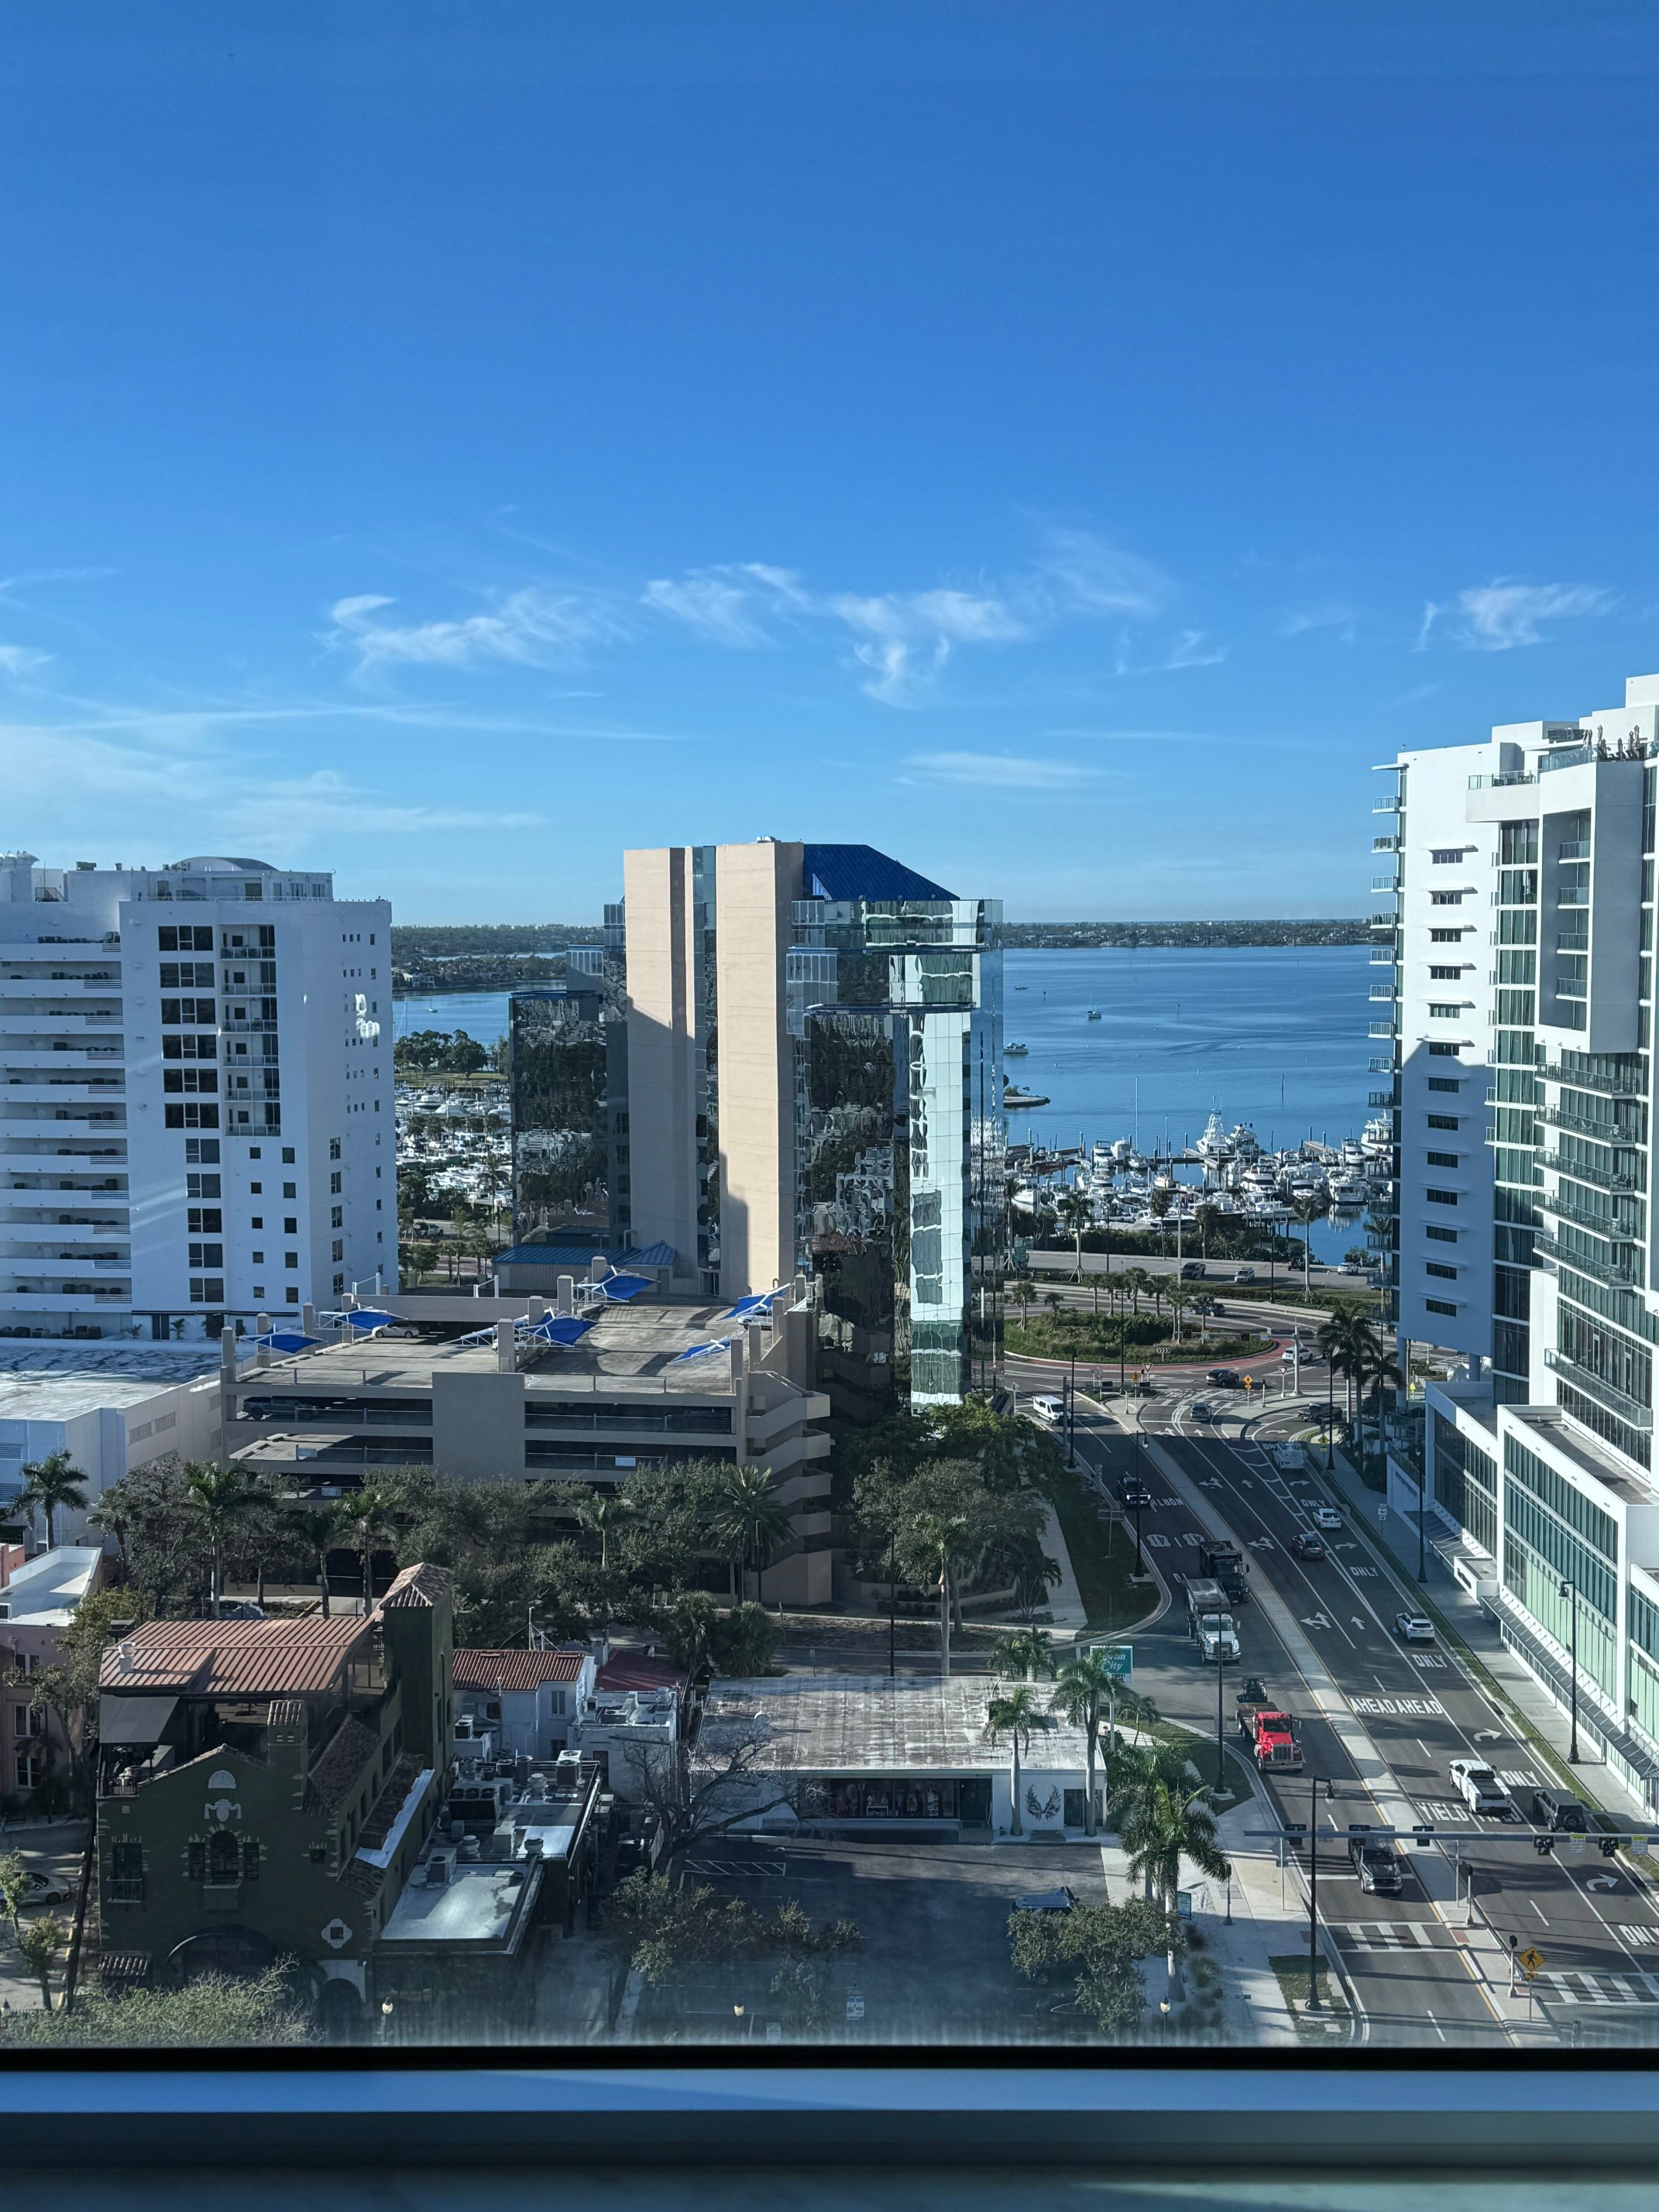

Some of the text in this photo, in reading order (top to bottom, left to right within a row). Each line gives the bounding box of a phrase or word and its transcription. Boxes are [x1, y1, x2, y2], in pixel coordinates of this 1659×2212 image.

[1301, 1499, 1326, 1507] ONLY
[1350, 1566, 1379, 1577] ONLY
[1100, 1660, 1123, 1672] City
[1411, 1654, 1448, 1668] ONLY
[1349, 1698, 1397, 1713] AHEAD
[1395, 1699, 1444, 1714] AHEAD
[1499, 1771, 1542, 1787] ONLY
[1414, 1802, 1470, 1822] YIELD
